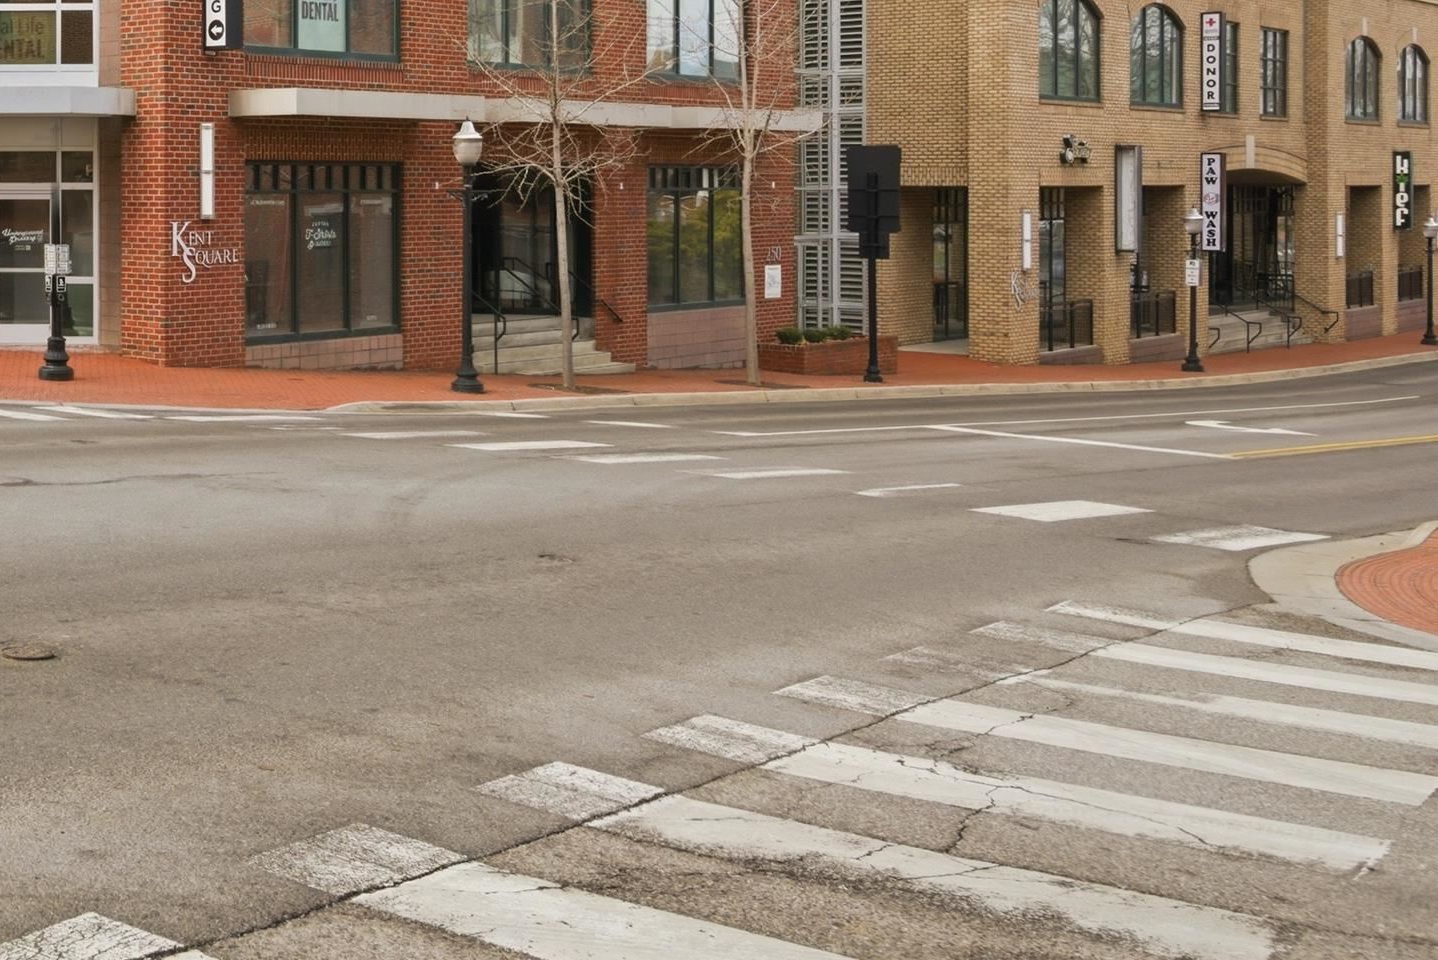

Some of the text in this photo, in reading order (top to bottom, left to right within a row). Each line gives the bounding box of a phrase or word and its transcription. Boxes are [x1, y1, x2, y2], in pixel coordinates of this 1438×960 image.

[302, 0, 339, 22] DENTAL
[1206, 44, 1217, 100] DONOR
[1204, 158, 1218, 247] PAW WASH
[170, 221, 214, 257] KENT
[182, 247, 239, 284] SQUARE
